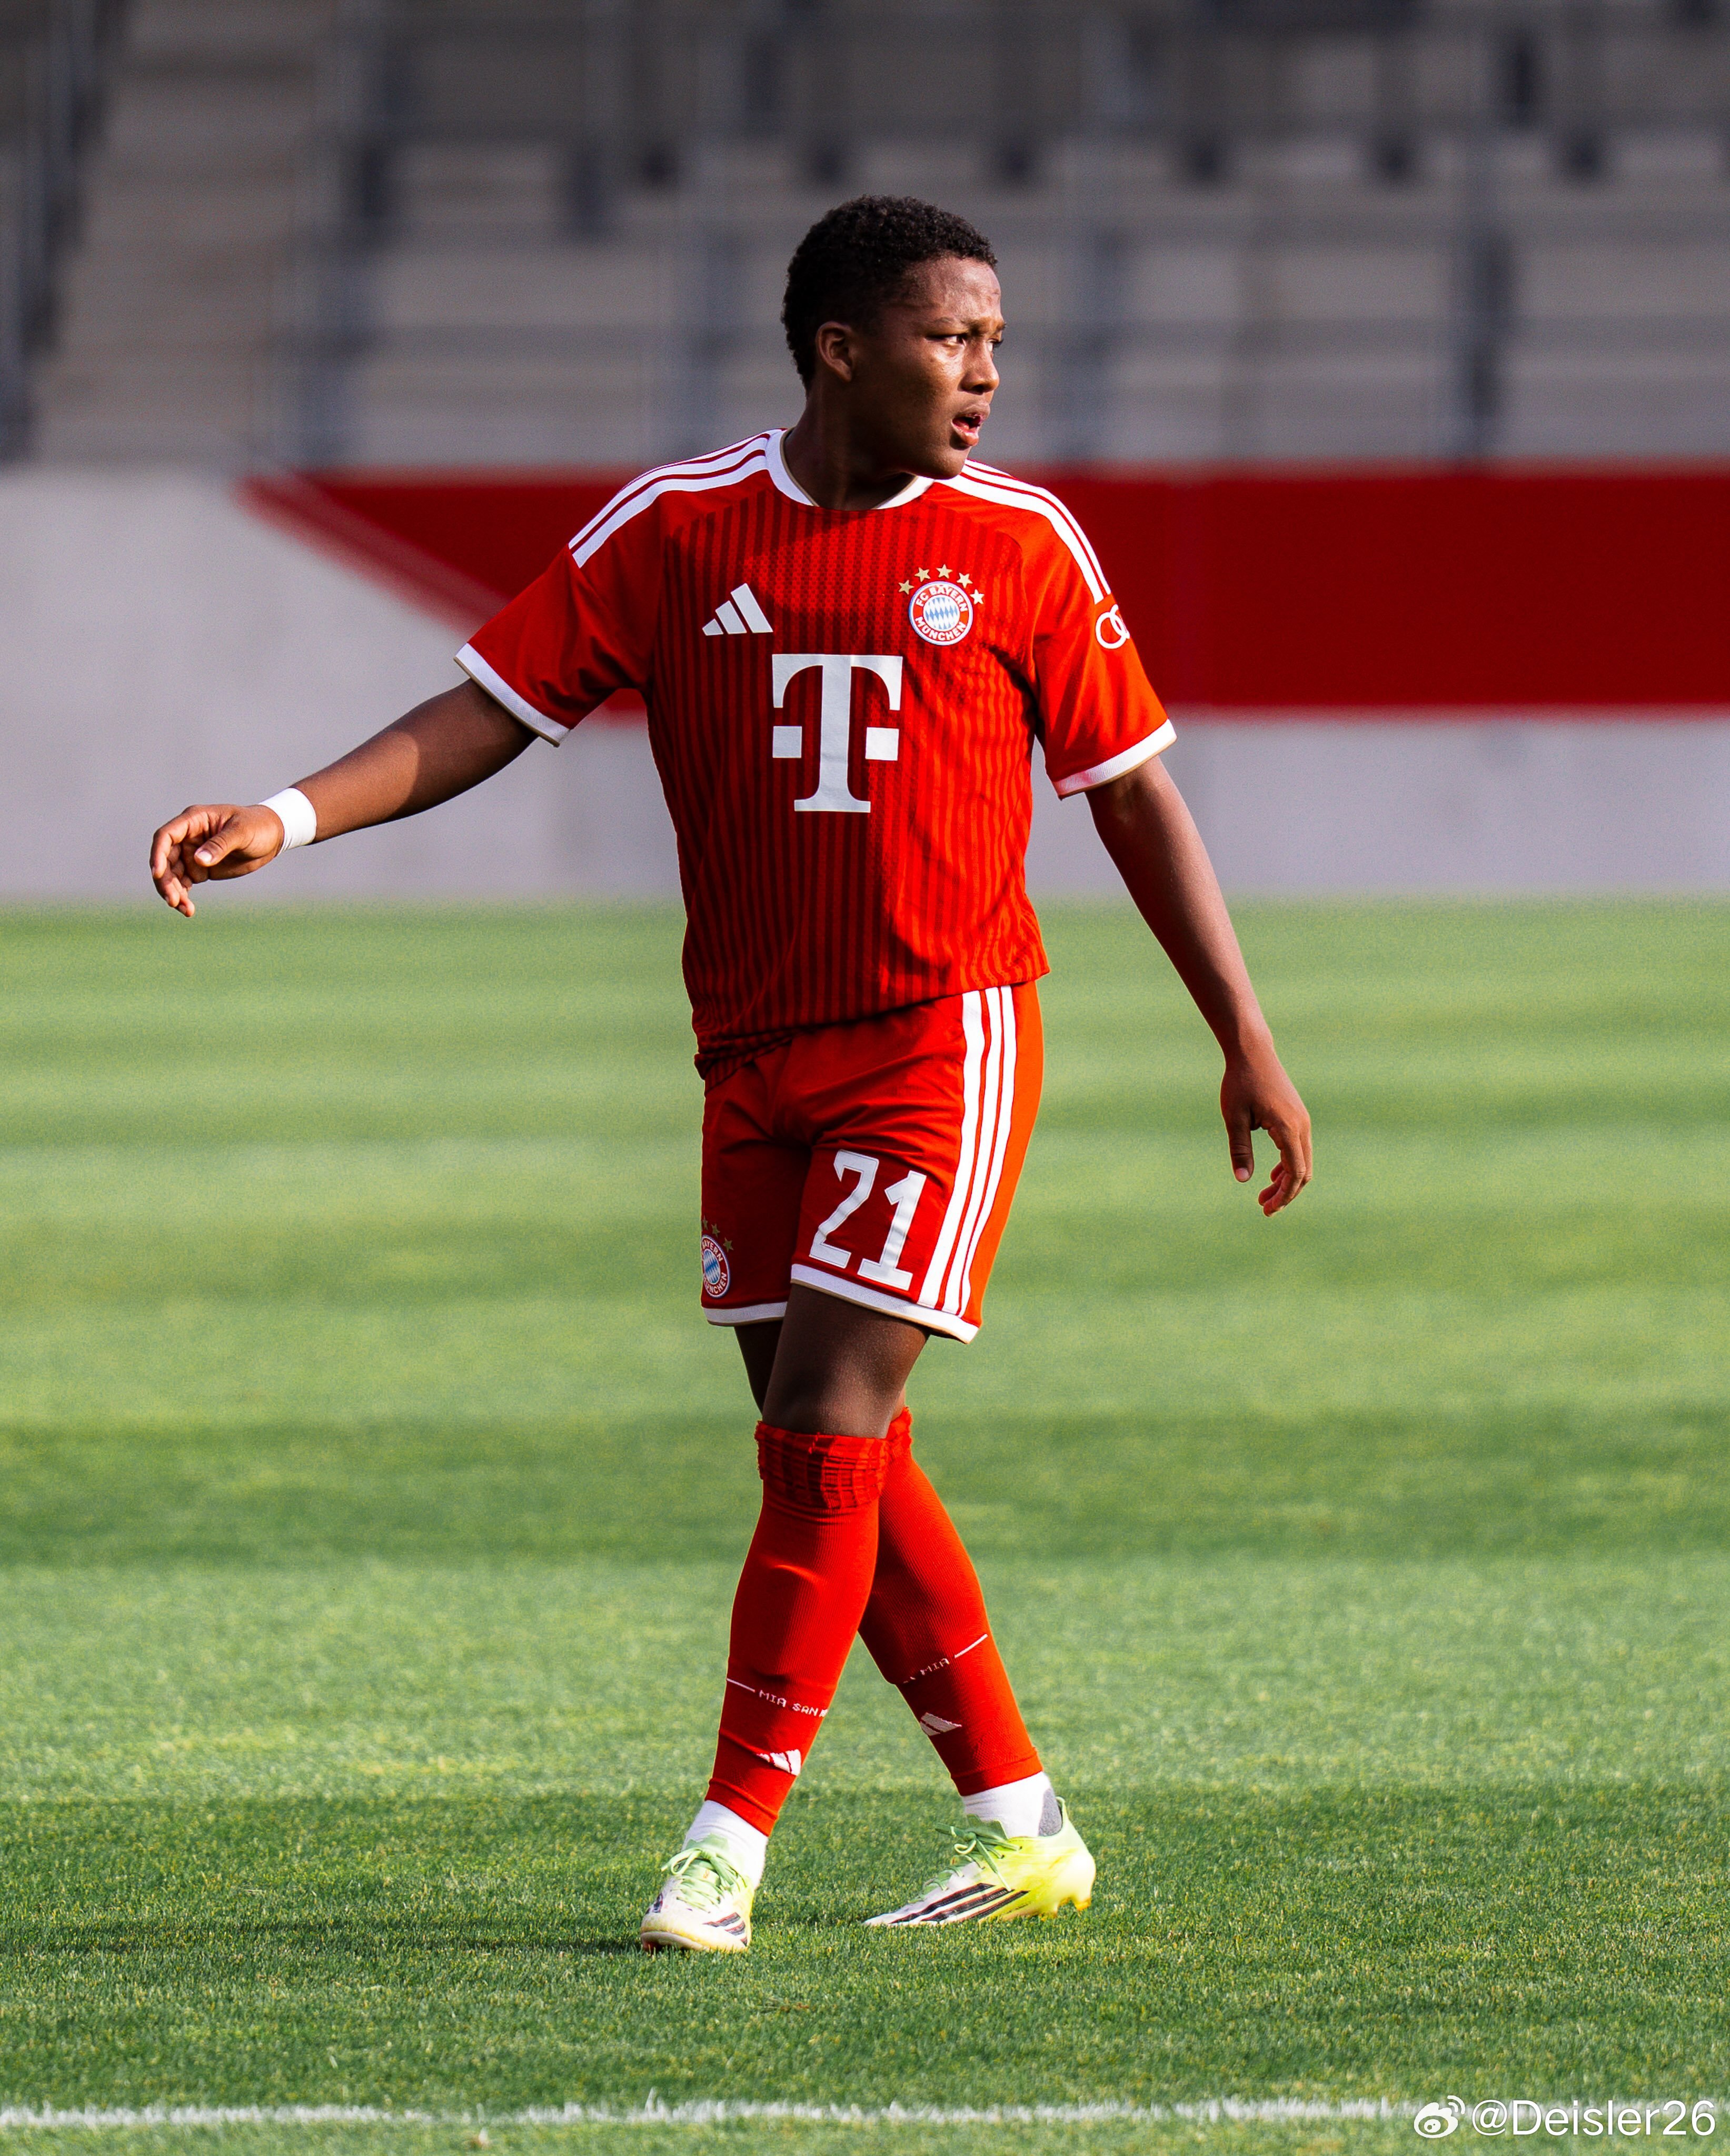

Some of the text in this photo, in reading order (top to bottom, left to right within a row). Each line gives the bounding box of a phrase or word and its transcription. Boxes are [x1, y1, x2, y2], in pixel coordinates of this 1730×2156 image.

[916, 585, 968, 612] FC BAYERN
[772, 654, 902, 813] T
[809, 1150, 927, 1291] 21
[759, 1690, 787, 1708] MIA
[792, 1703, 819, 1716] SAN
